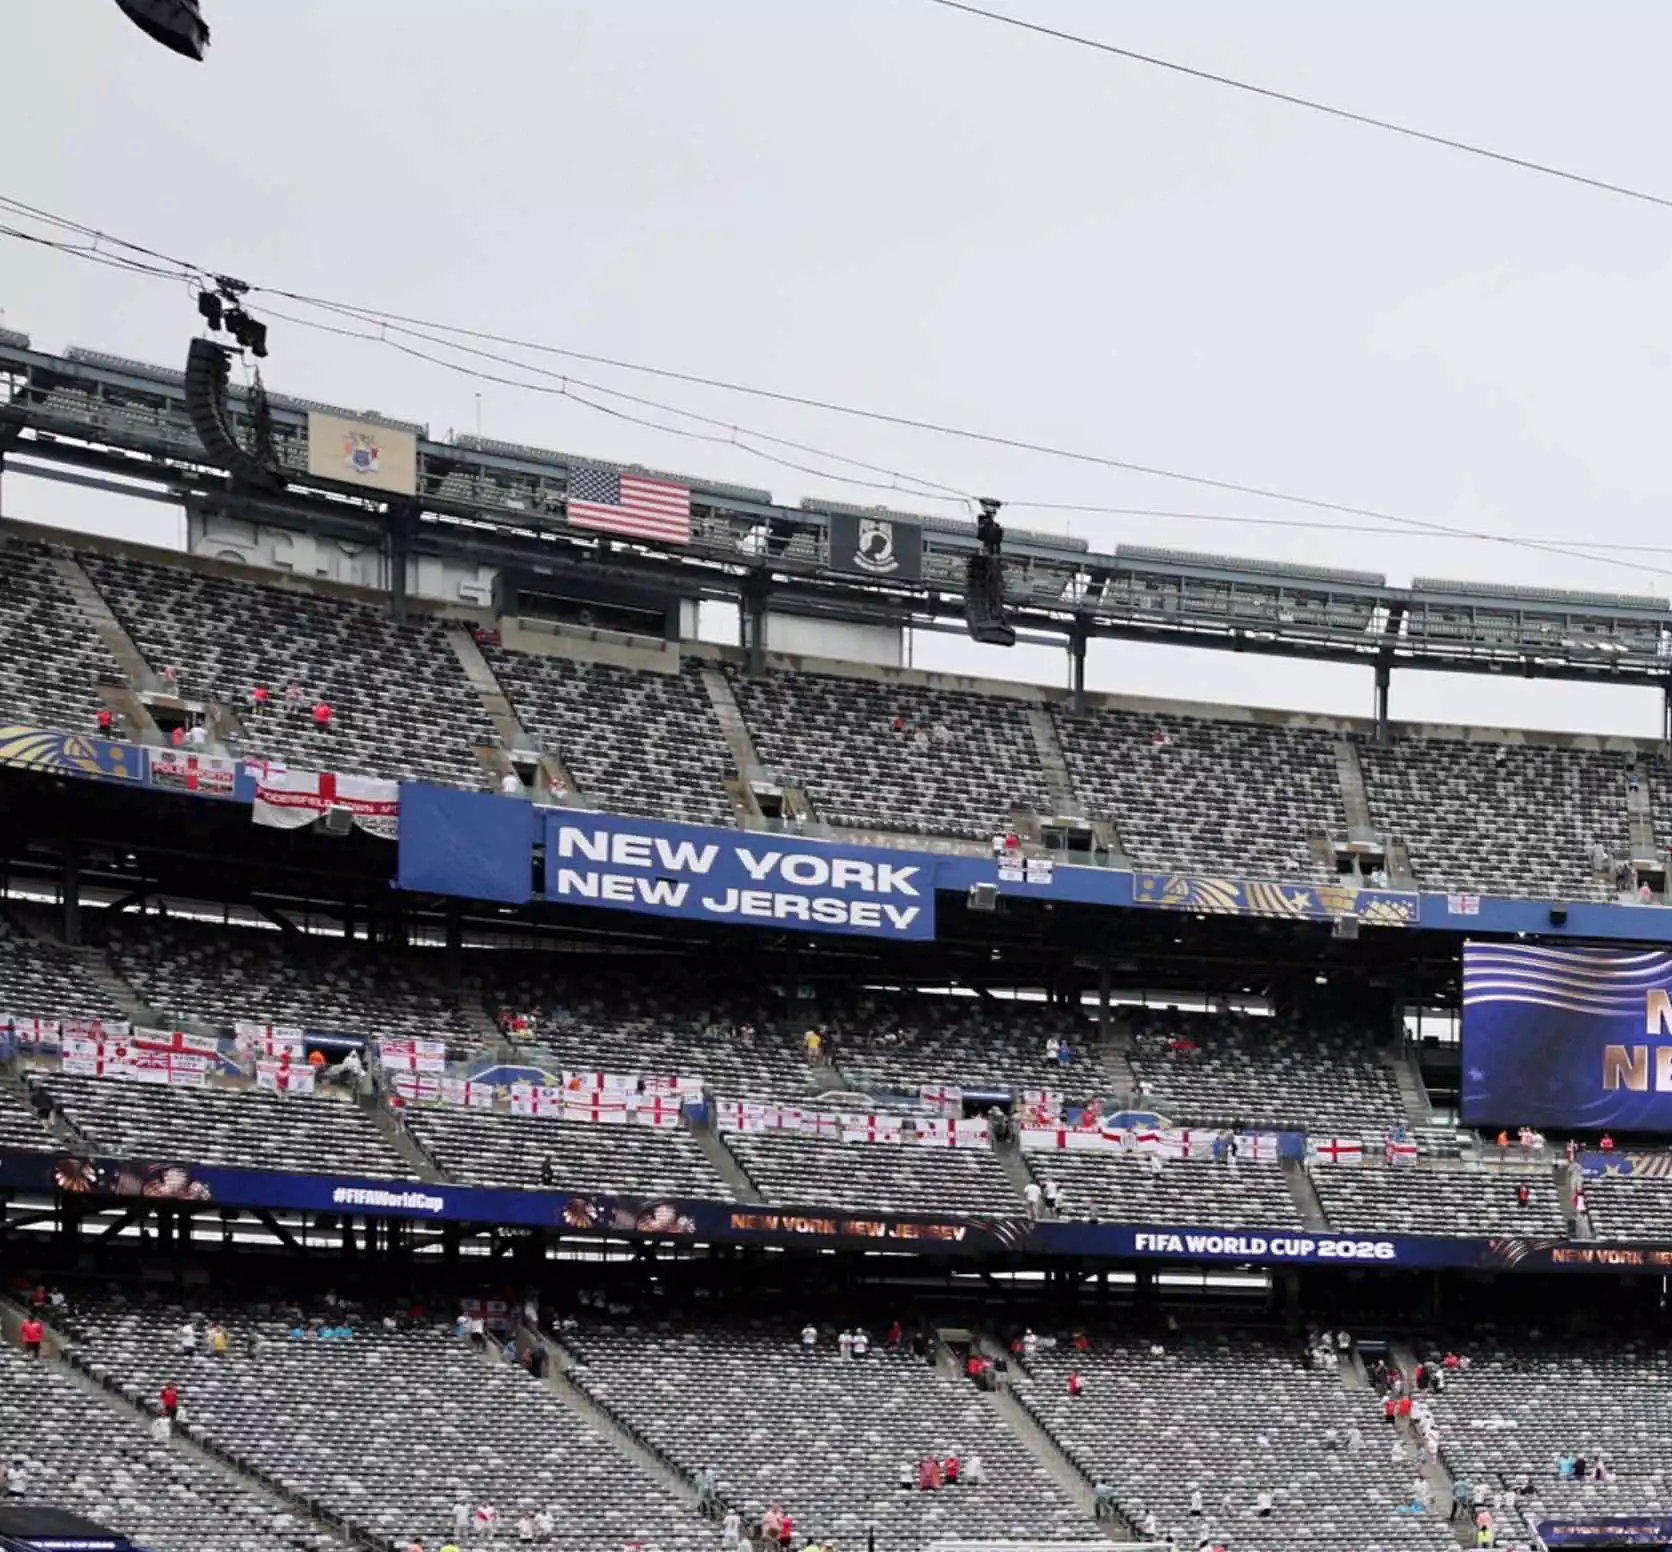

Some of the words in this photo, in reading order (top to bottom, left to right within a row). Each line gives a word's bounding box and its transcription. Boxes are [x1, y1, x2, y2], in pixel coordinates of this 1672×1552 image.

[558, 827, 719, 873] NEW
[735, 848, 921, 896] YORK
[558, 870, 689, 907] NEW
[702, 888, 921, 930] JERSEY
[333, 1187, 443, 1213] #FIFAWorldCup
[782, 1216, 836, 1234] YORK
[1135, 1233, 1184, 1252] FIFA
[1185, 1235, 1267, 1255] WORLD
[1270, 1238, 1315, 1256] CUP
[1317, 1241, 1395, 1259] 2026
